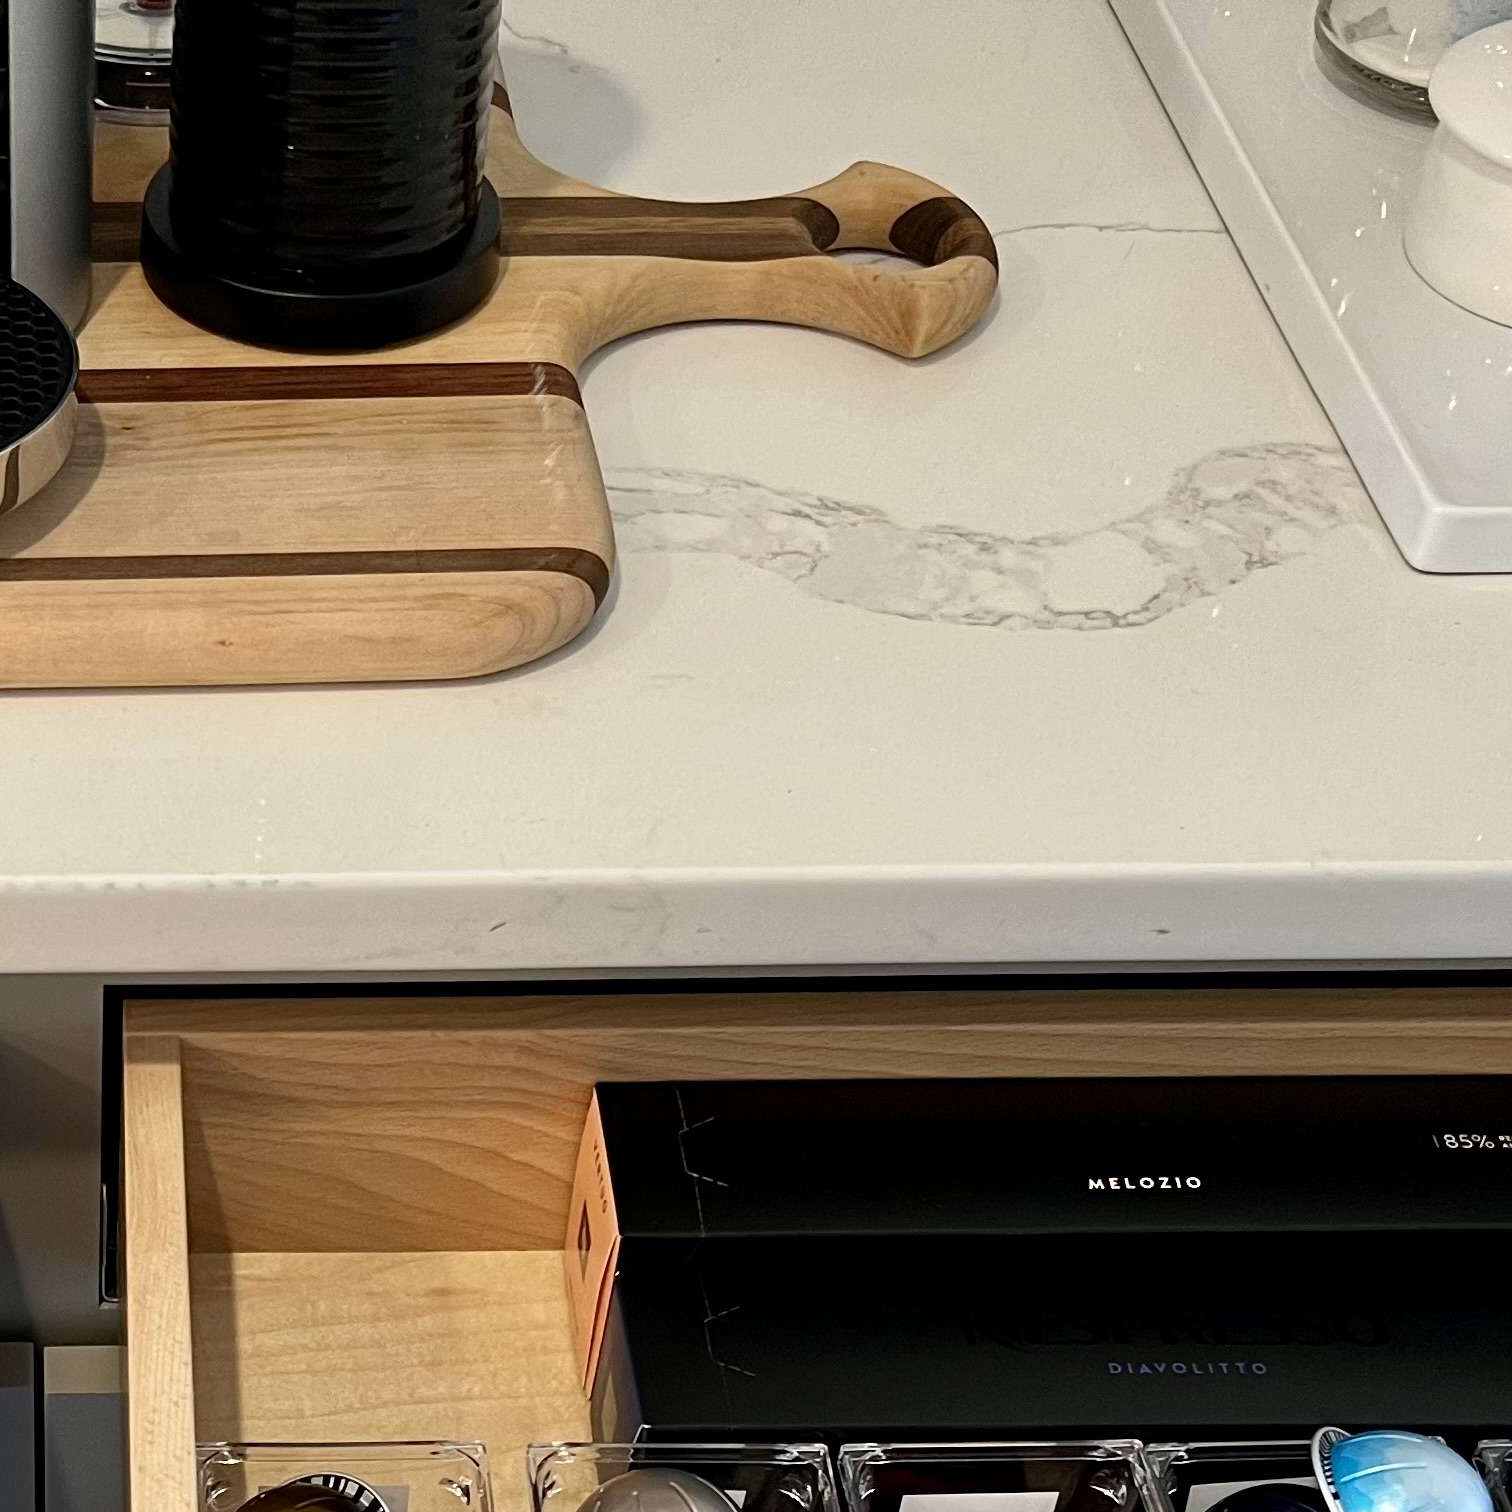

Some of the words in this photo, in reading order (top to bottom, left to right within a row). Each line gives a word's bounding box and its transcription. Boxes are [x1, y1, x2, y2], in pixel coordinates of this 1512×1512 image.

[1443, 1134, 1495, 1149] 85%
[1089, 1177, 1202, 1190] MELOZIO
[1109, 1362, 1268, 1375] DIAVOLITTO
